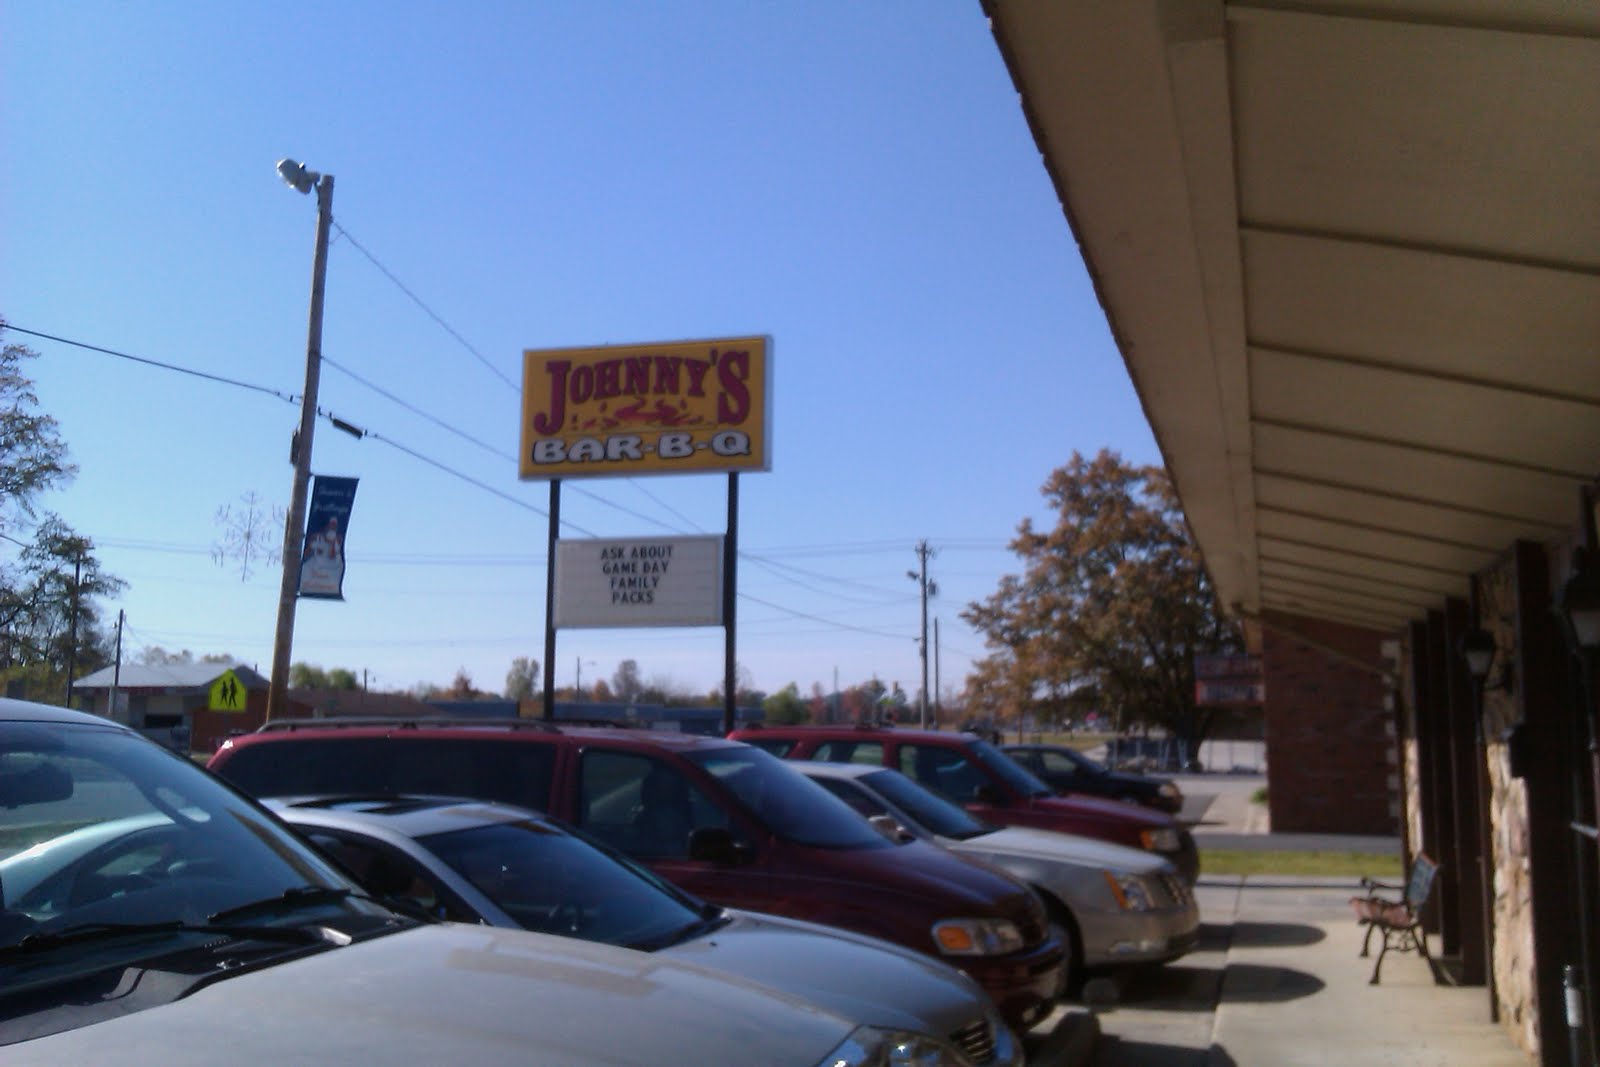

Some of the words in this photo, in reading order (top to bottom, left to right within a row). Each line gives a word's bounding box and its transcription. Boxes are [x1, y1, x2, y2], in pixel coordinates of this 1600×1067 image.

[533, 347, 751, 436] JOHNNY'S
[532, 430, 752, 465] BAR-B-Q
[600, 547, 625, 561] ASK
[631, 544, 674, 559] ABOUT
[602, 562, 637, 575] GAME
[643, 560, 670, 574] DAY
[610, 576, 661, 590] FAMILY
[612, 590, 655, 605] PACKS
